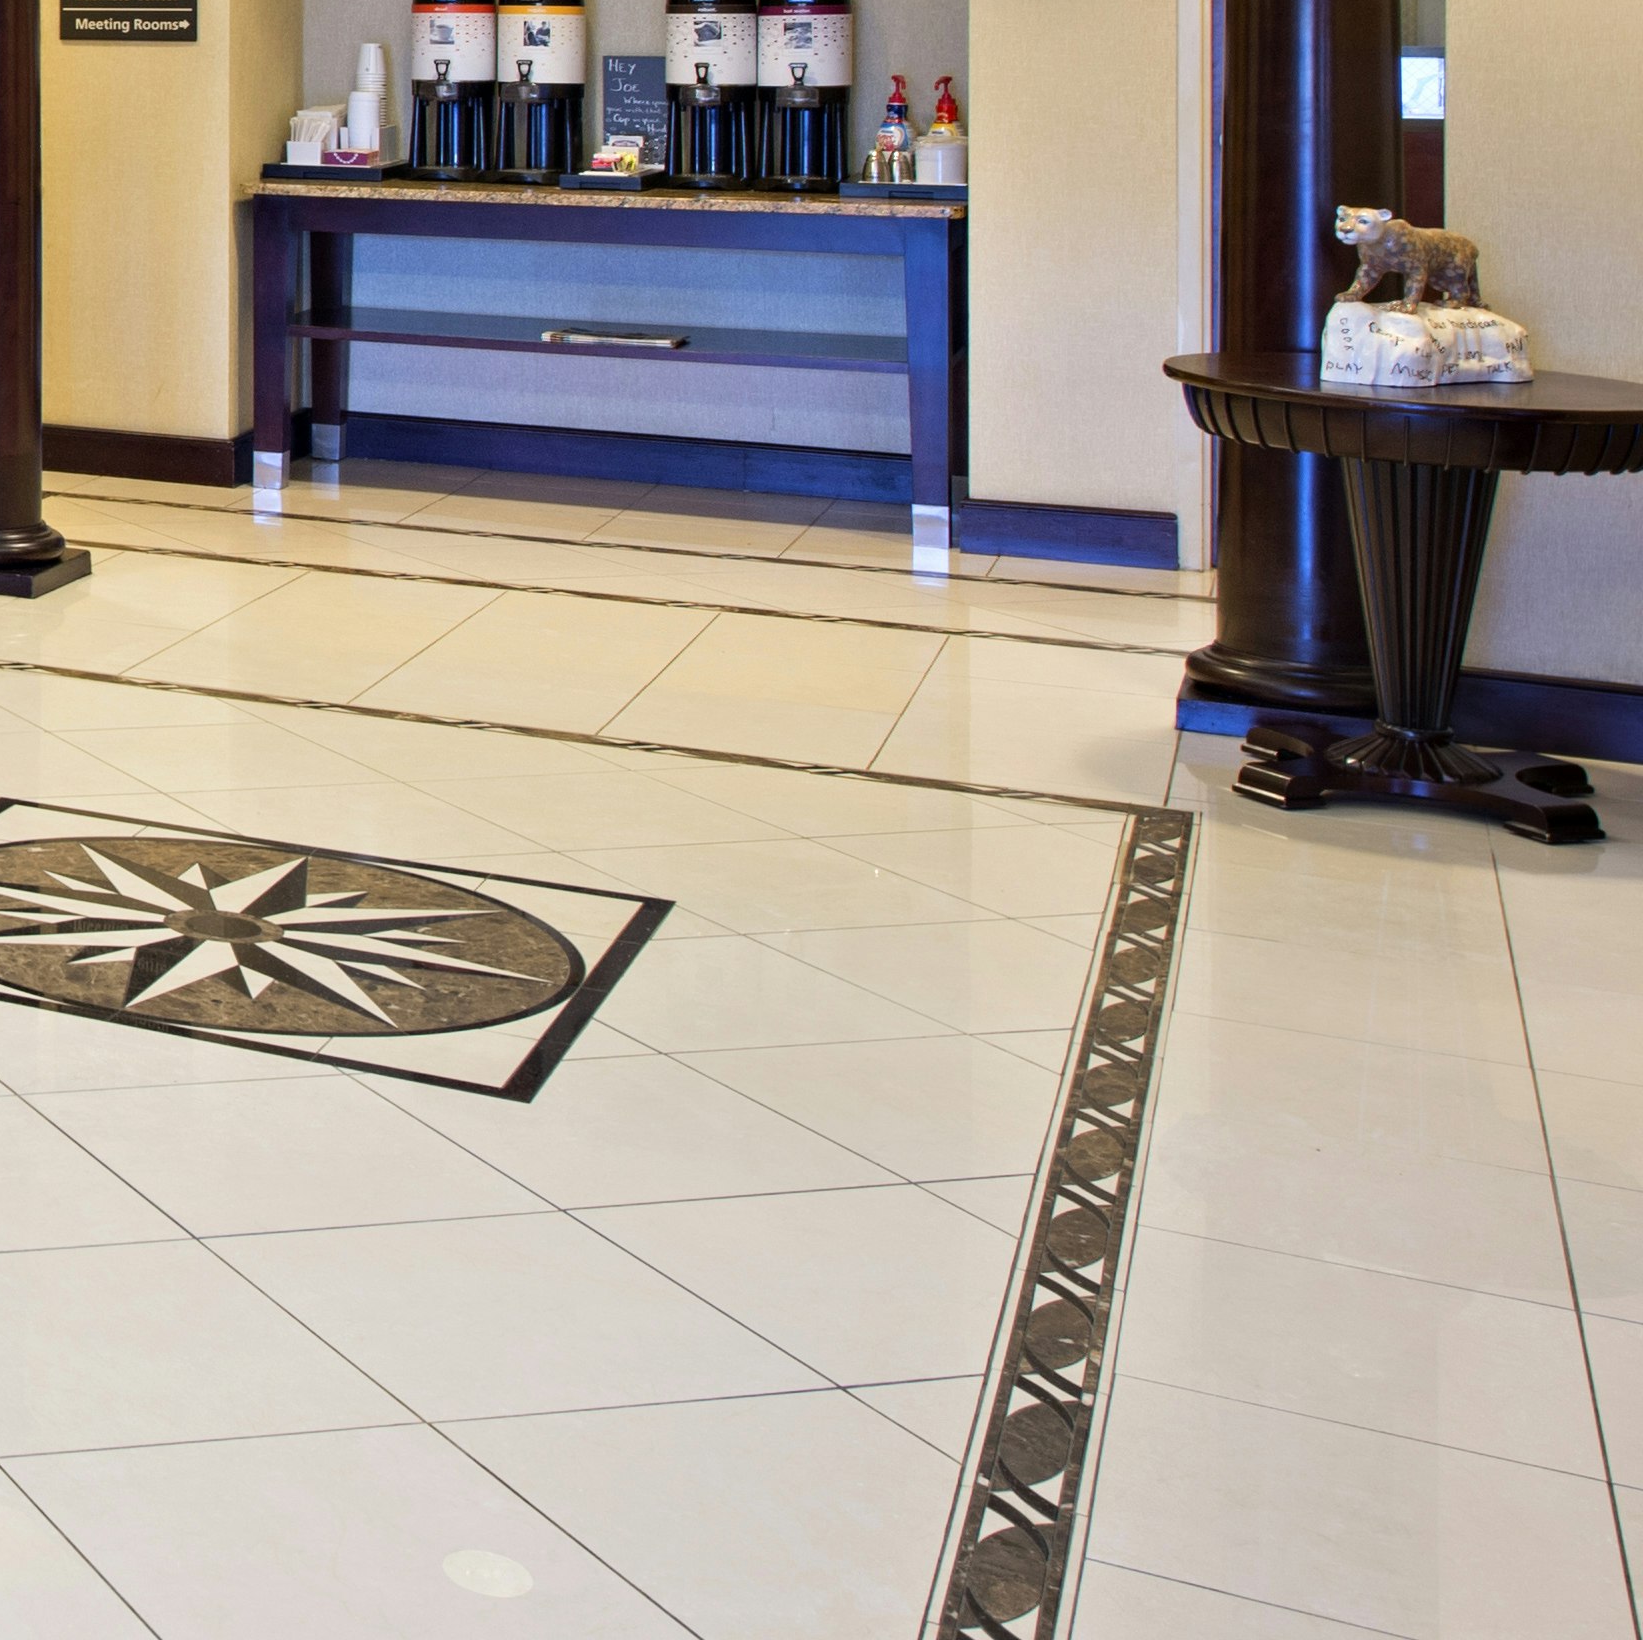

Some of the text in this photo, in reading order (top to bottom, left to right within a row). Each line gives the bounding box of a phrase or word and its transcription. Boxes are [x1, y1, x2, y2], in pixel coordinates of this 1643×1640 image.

[75, 18, 179, 33] Meeting Rooms
[608, 58, 636, 75] HEY
[611, 77, 640, 92] JOE
[1326, 360, 1363, 374] PLAY
